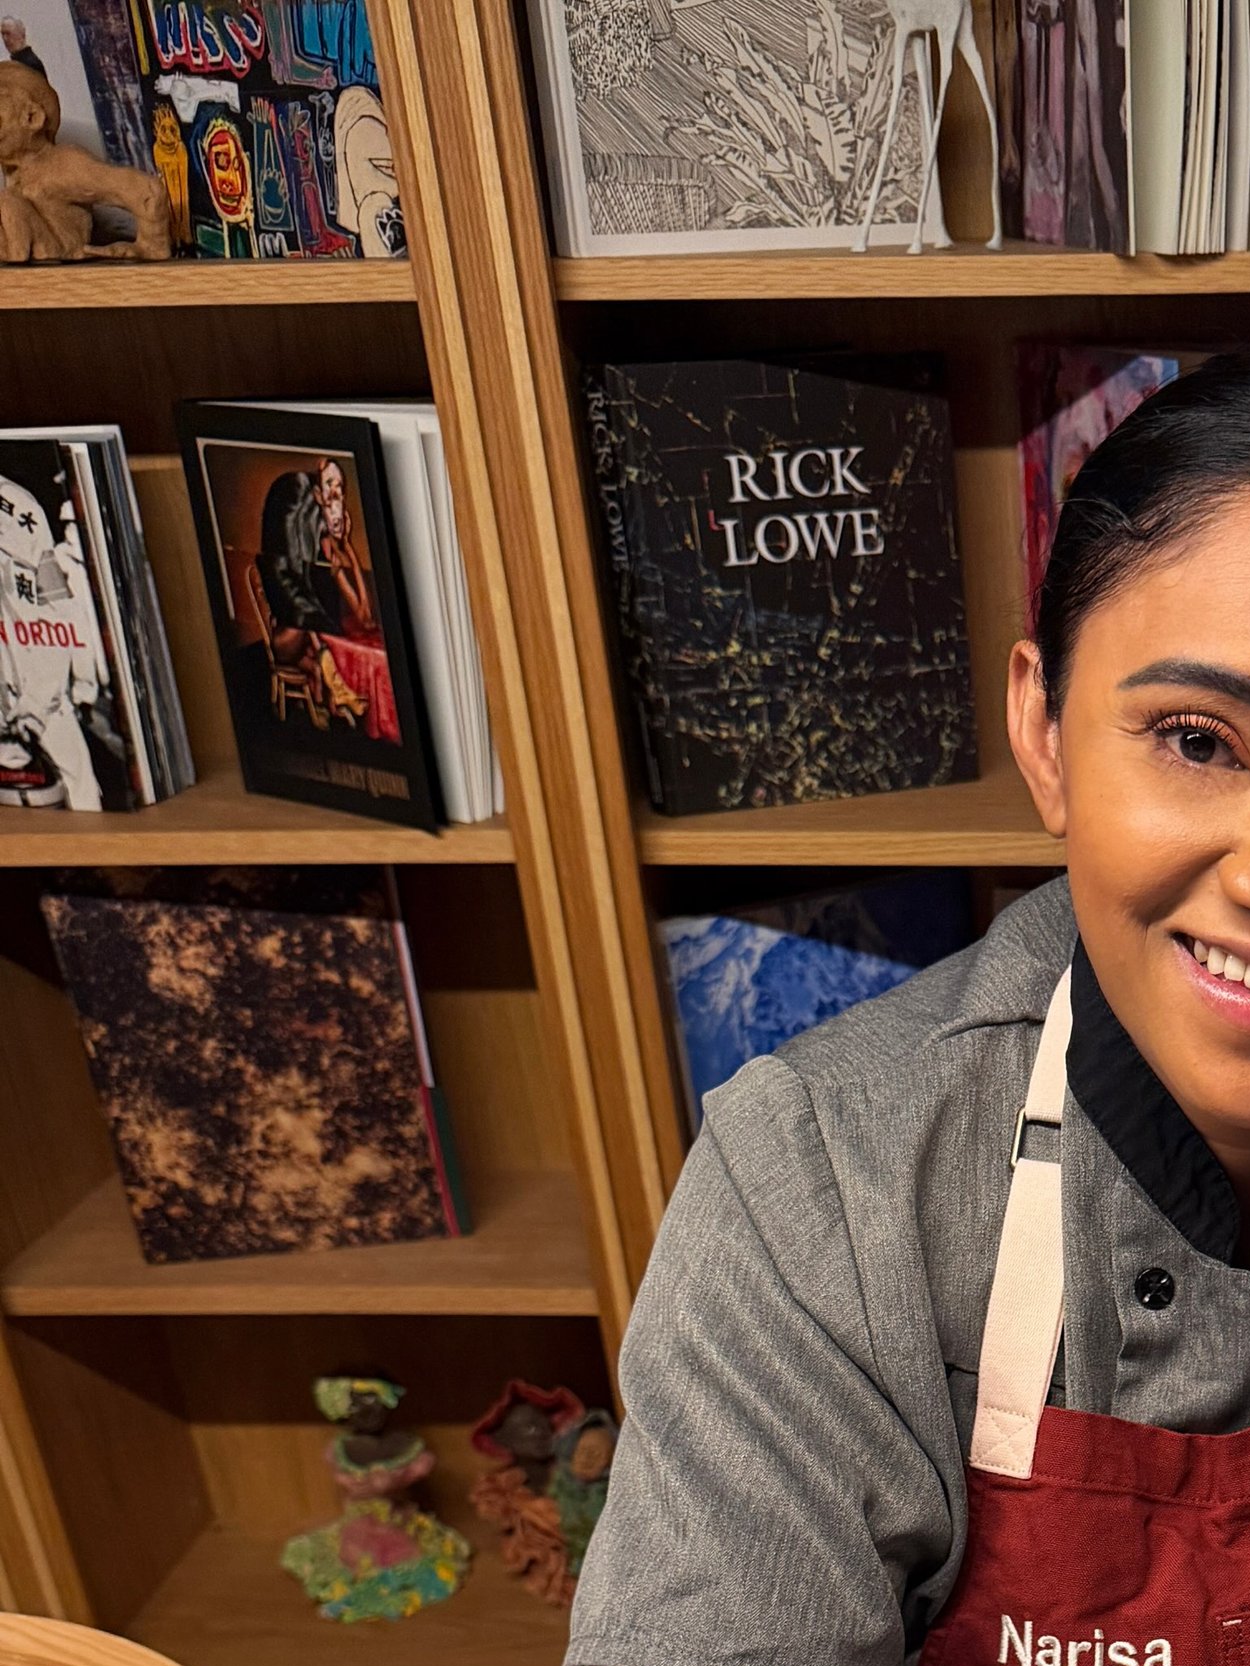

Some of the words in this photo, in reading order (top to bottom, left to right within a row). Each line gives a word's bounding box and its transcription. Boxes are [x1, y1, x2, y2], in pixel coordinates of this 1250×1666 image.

[723, 447, 872, 503] RICK
[717, 509, 885, 567] LOWE
[14, 620, 87, 649] ORIOL
